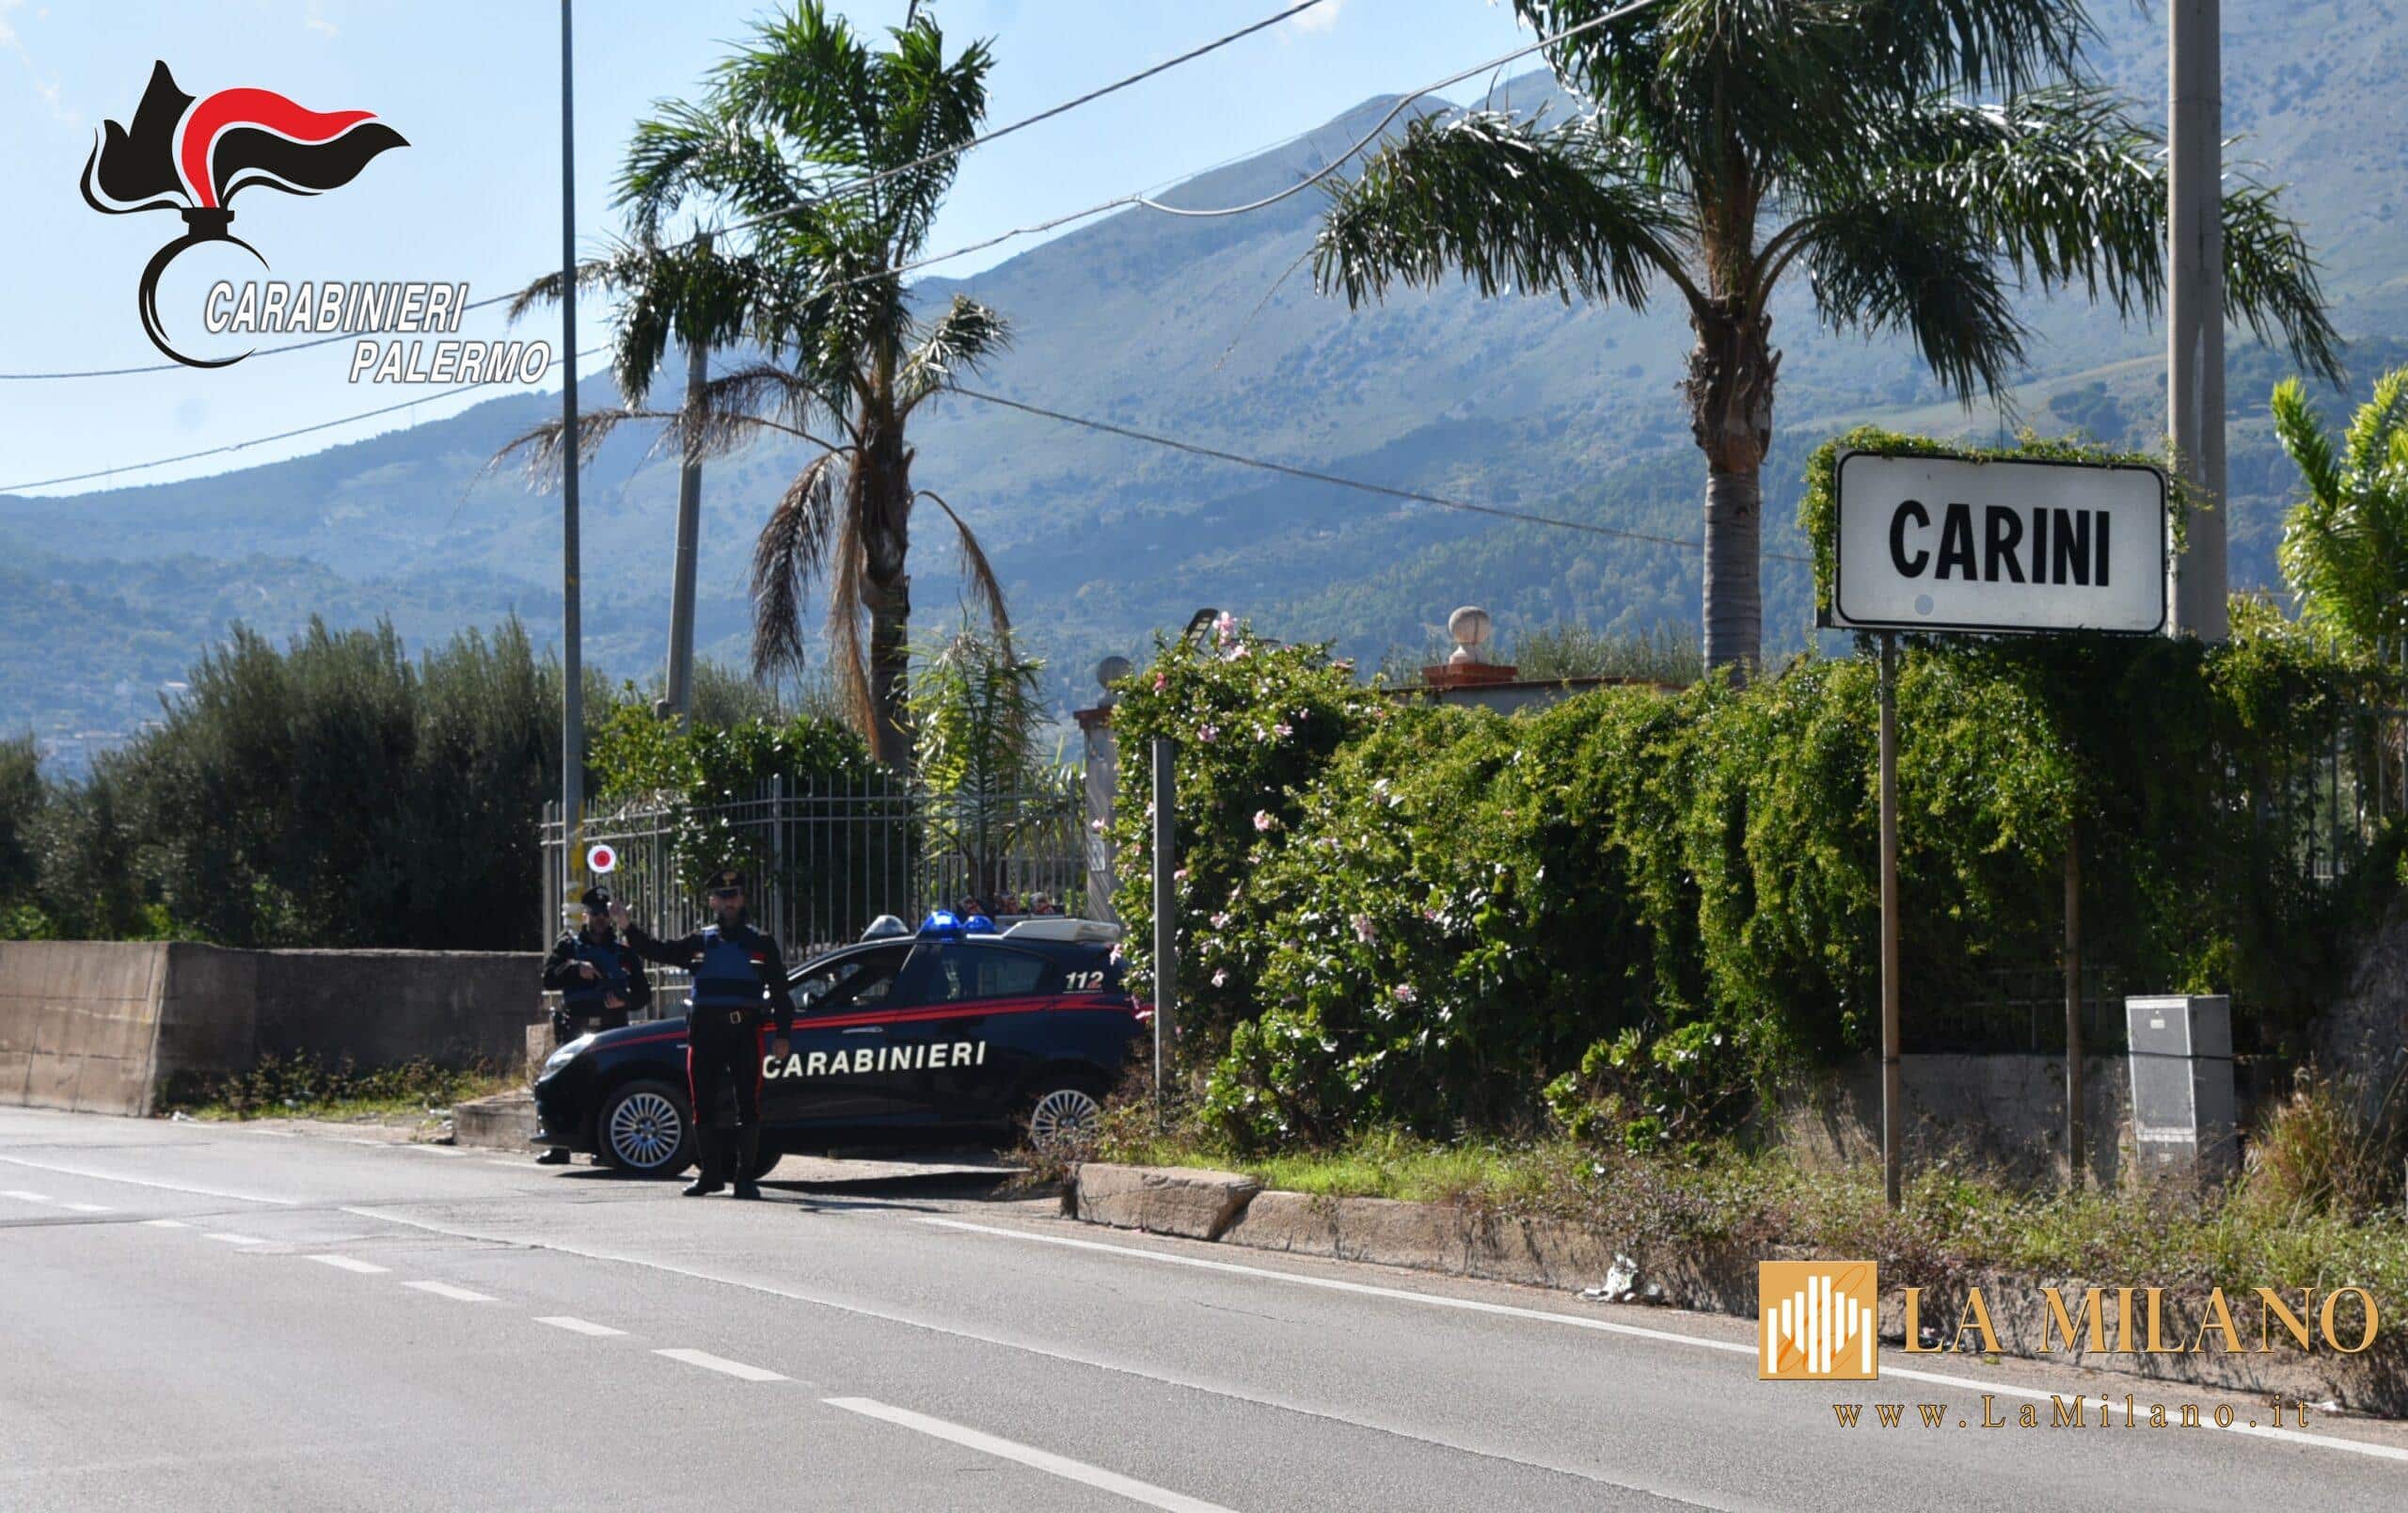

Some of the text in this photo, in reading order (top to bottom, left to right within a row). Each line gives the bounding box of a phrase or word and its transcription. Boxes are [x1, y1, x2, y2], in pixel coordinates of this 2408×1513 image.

[1889, 500, 2110, 586] CARINI
[1066, 971, 1104, 990] 112
[762, 1041, 987, 1079] CARABINIERI
